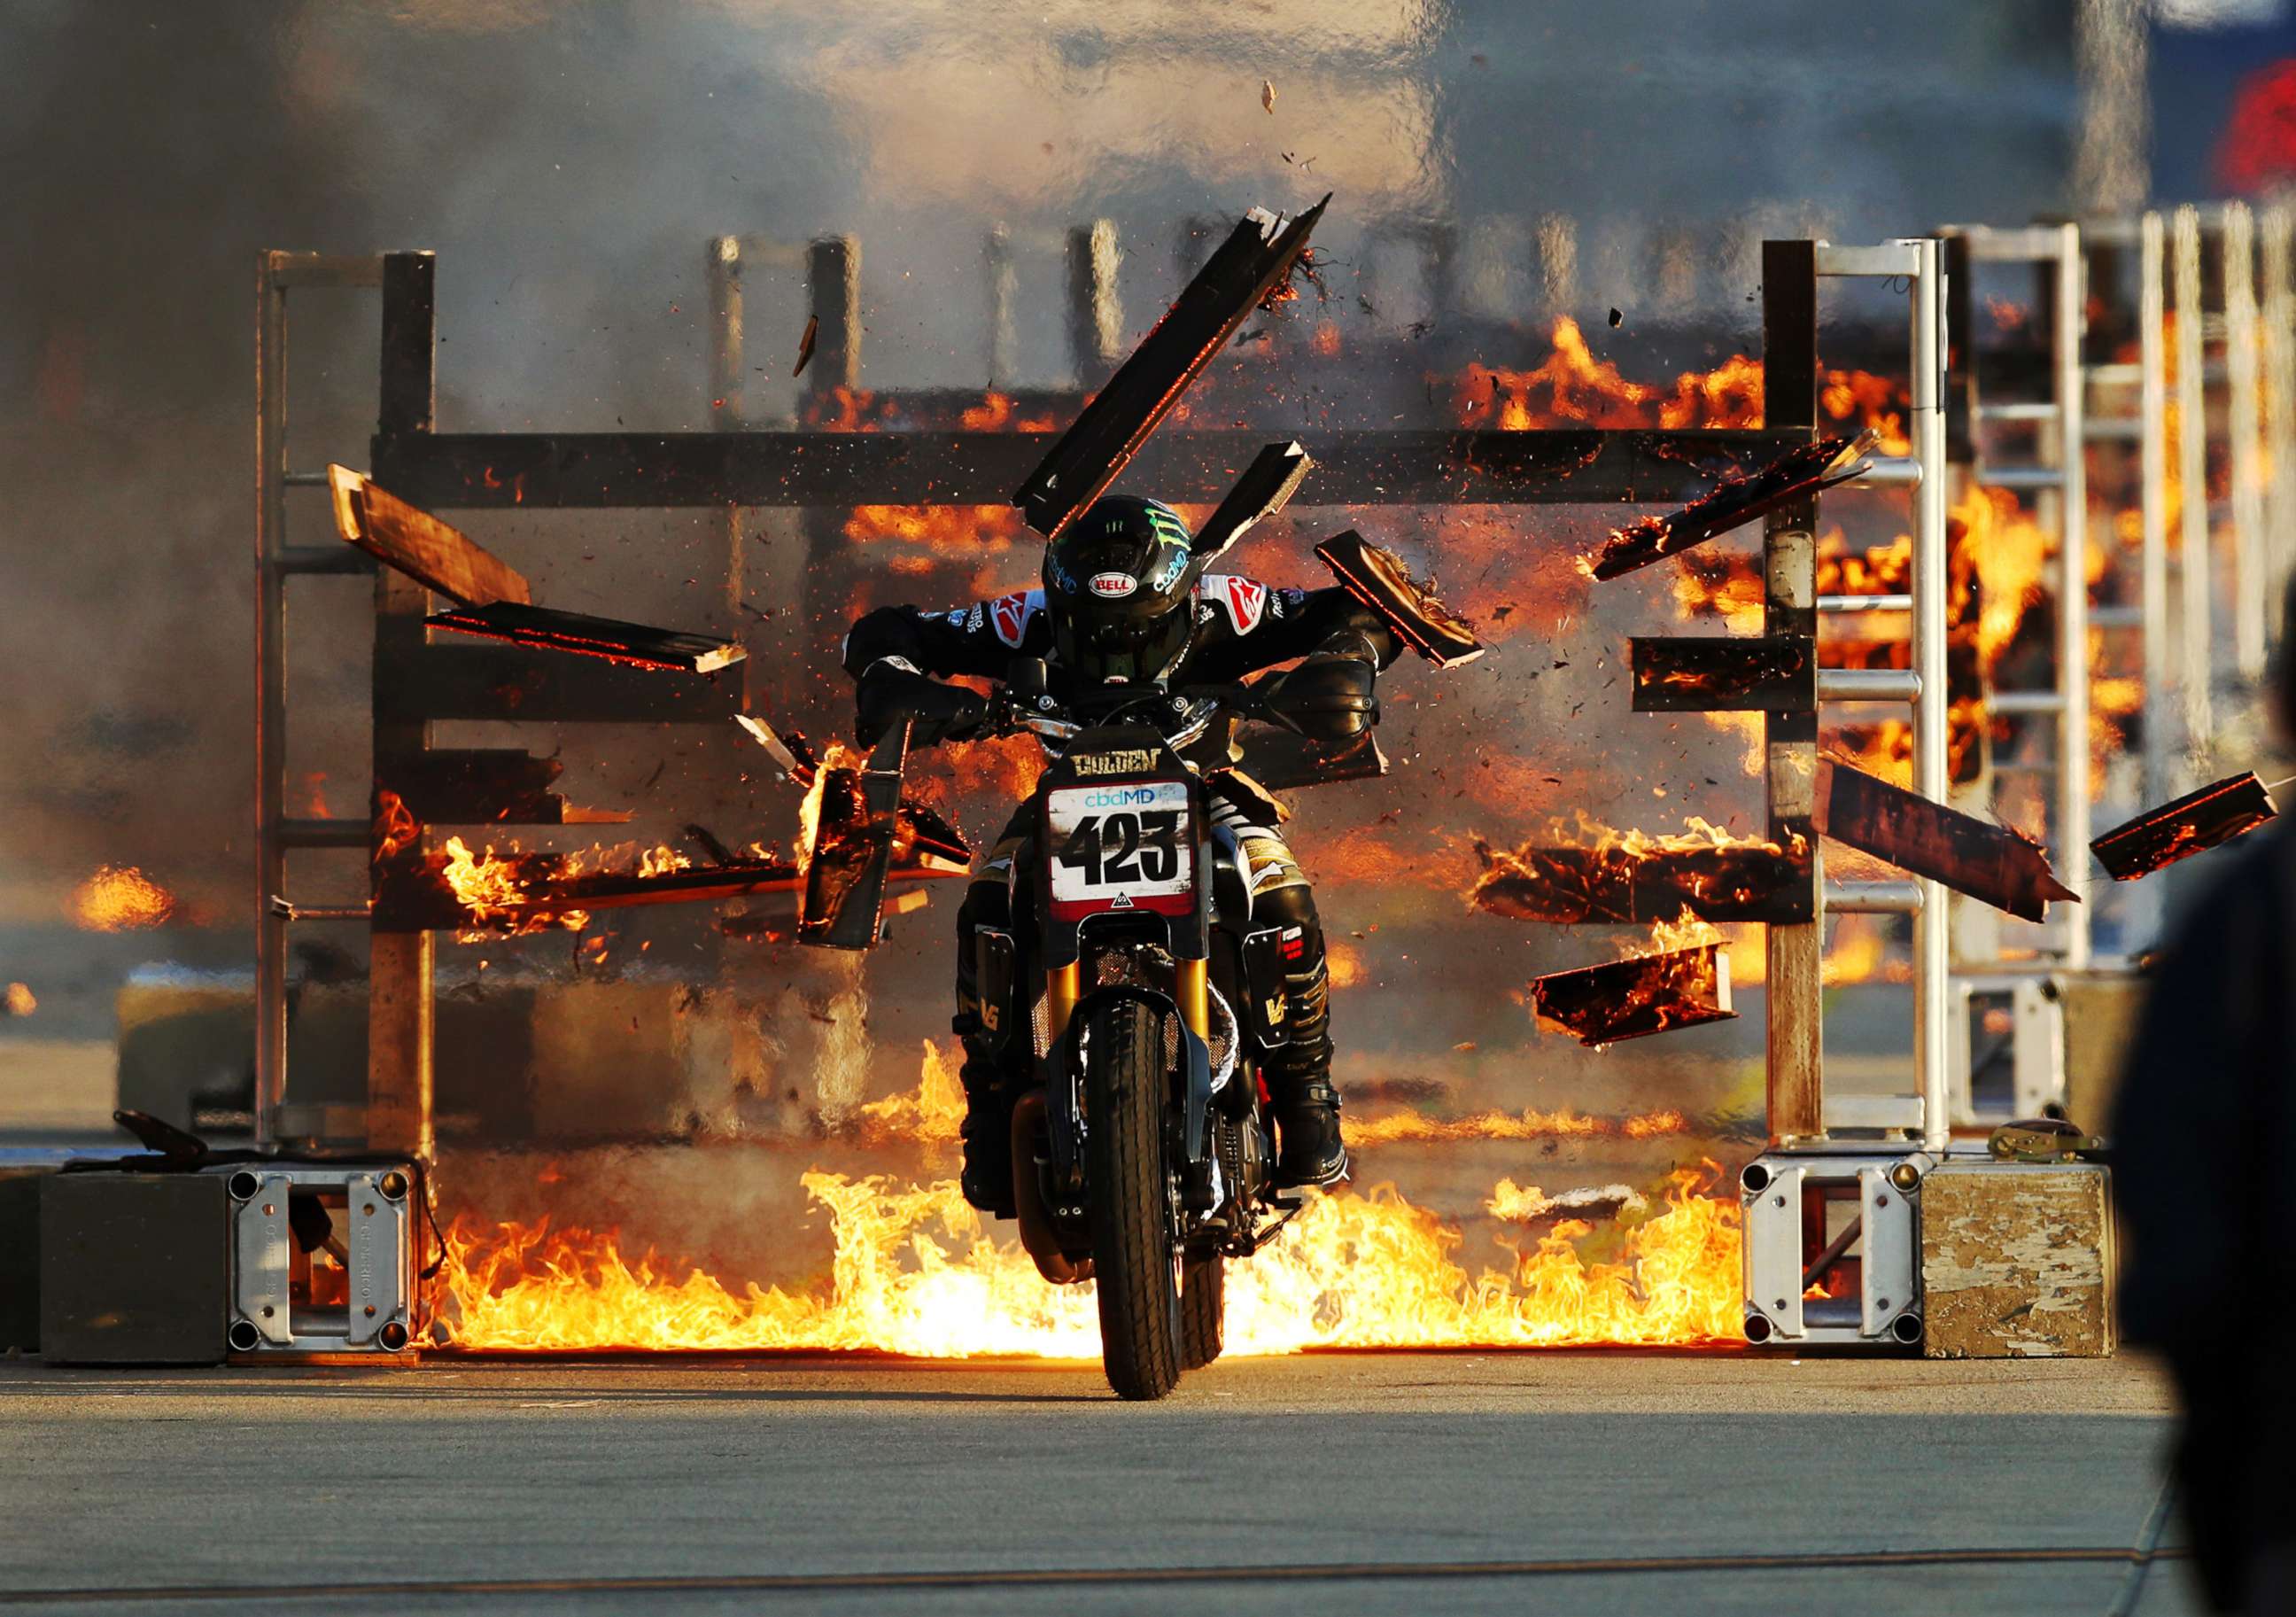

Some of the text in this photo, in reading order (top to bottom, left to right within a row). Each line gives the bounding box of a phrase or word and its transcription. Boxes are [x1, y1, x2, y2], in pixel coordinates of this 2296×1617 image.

[1095, 579, 1130, 591] BELL
[1070, 748, 1162, 777] GOLDEN
[1085, 789, 1155, 808] cbdMD
[1058, 811, 1179, 886] 423
